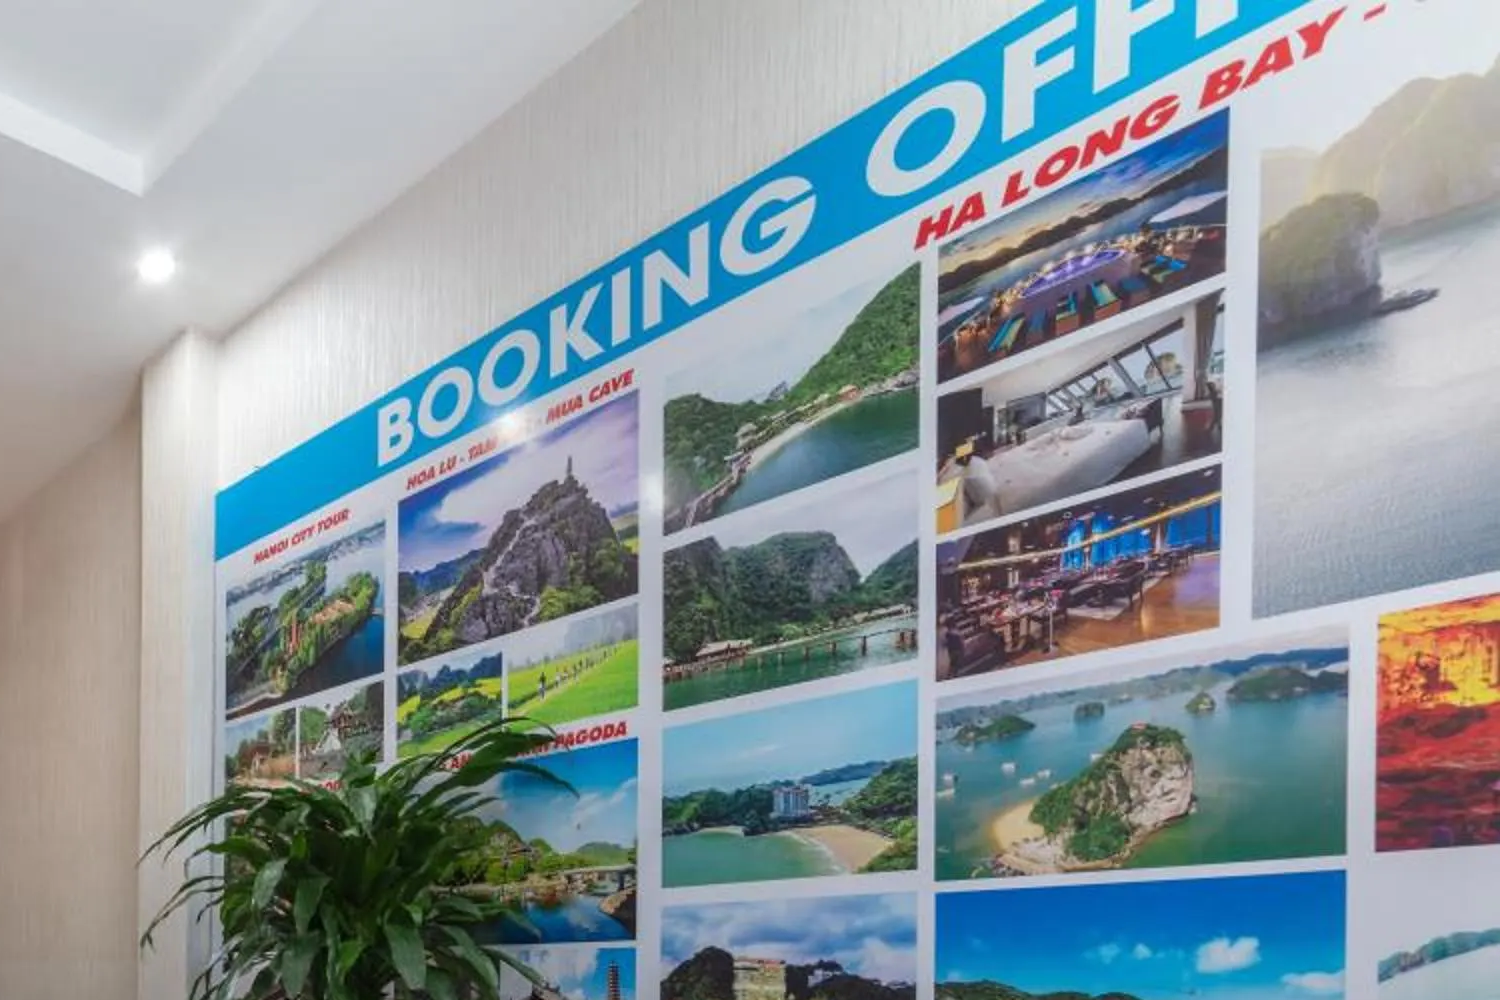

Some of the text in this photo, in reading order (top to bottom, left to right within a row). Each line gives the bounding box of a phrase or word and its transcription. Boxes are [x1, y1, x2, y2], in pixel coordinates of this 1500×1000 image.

[914, 192, 987, 249] HA
[1001, 94, 1180, 206] LONG
[1198, 5, 1348, 110] BAY
[378, 175, 817, 467] BOOKING
[406, 465, 435, 490] HOA
[439, 455, 457, 476] LU
[546, 396, 583, 424] MUA
[589, 368, 635, 403] CAVE
[254, 508, 351, 564] HANOI CITY TOUR
[555, 720, 627, 748] PAGODA
